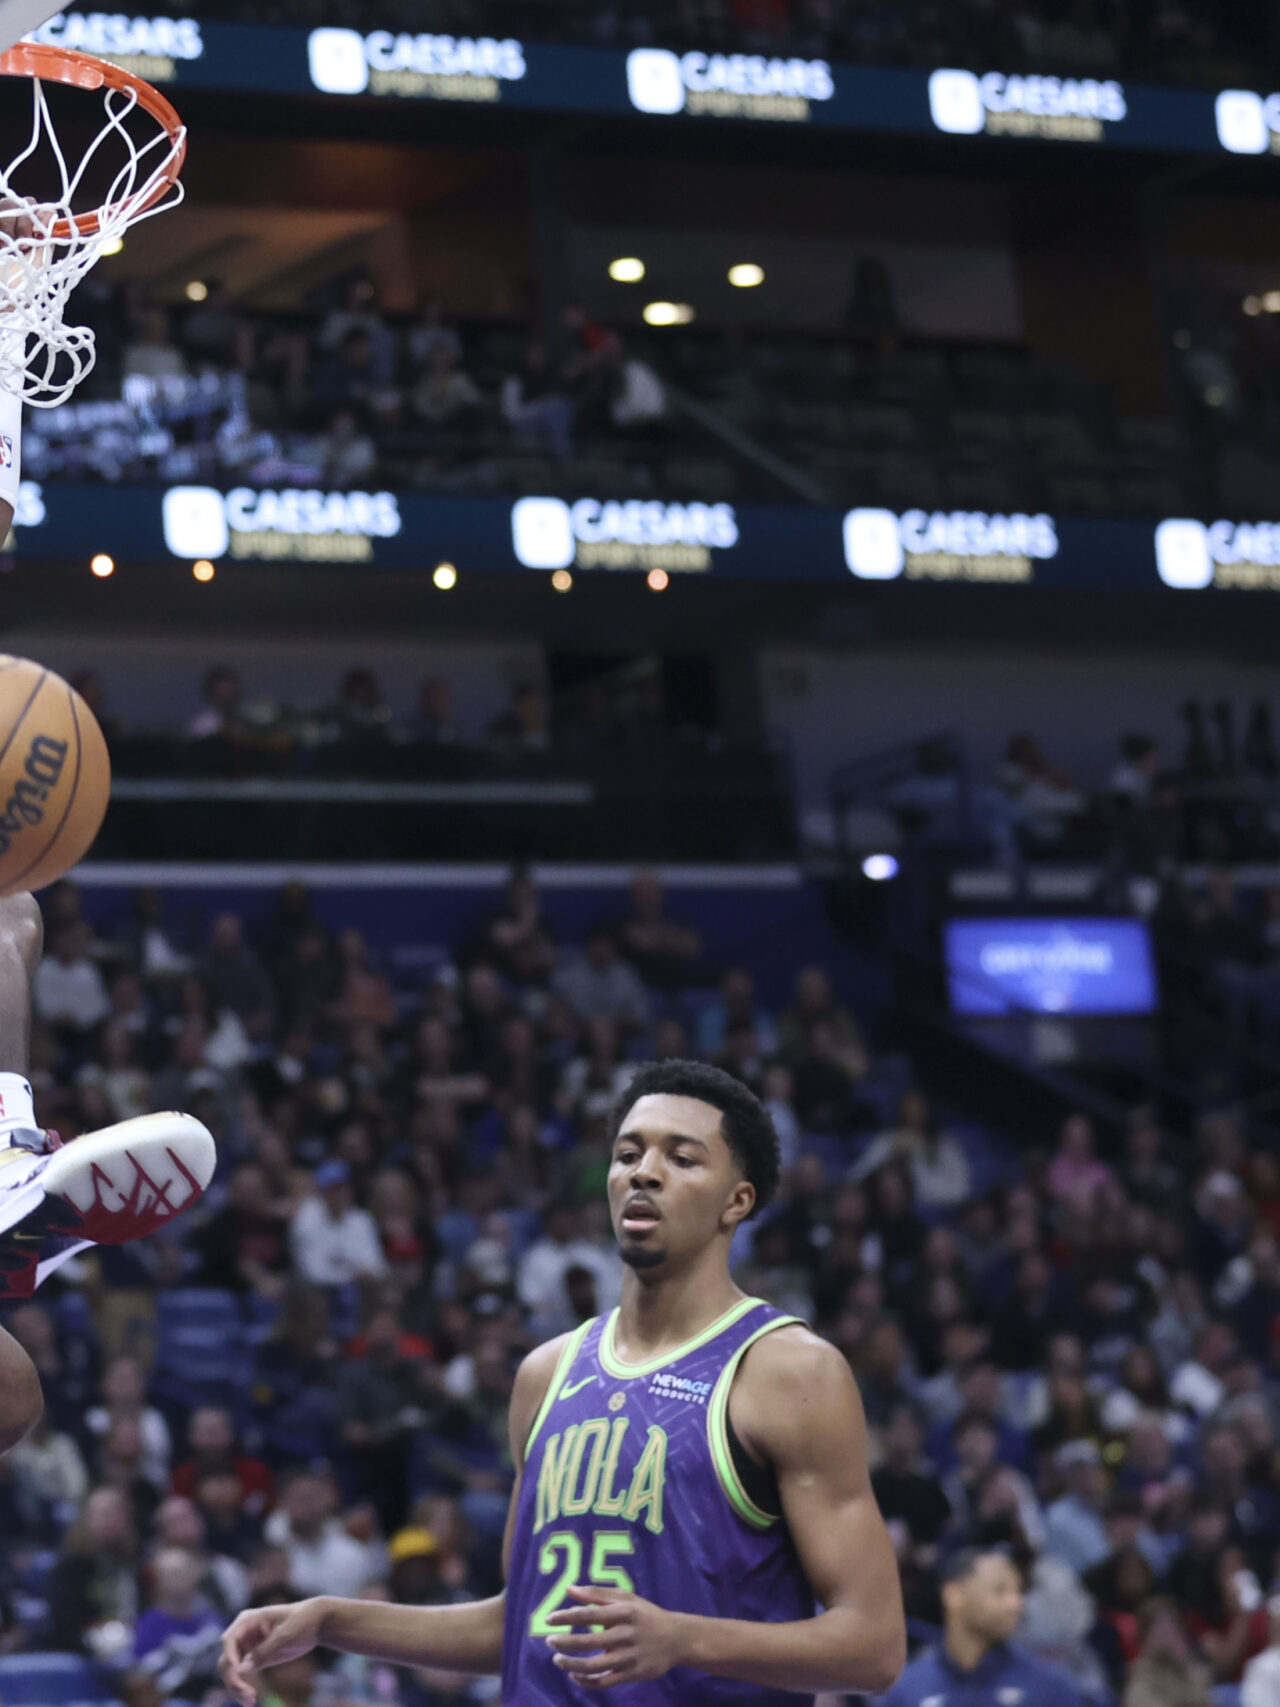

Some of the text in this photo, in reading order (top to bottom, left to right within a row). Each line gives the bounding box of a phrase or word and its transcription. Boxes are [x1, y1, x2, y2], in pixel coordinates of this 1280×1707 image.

[648, 1386, 705, 1404] PRODUCTS
[652, 1373, 712, 1395] NEWAGE
[533, 1417, 666, 1535] NOLA
[528, 1530, 635, 1637] 25
